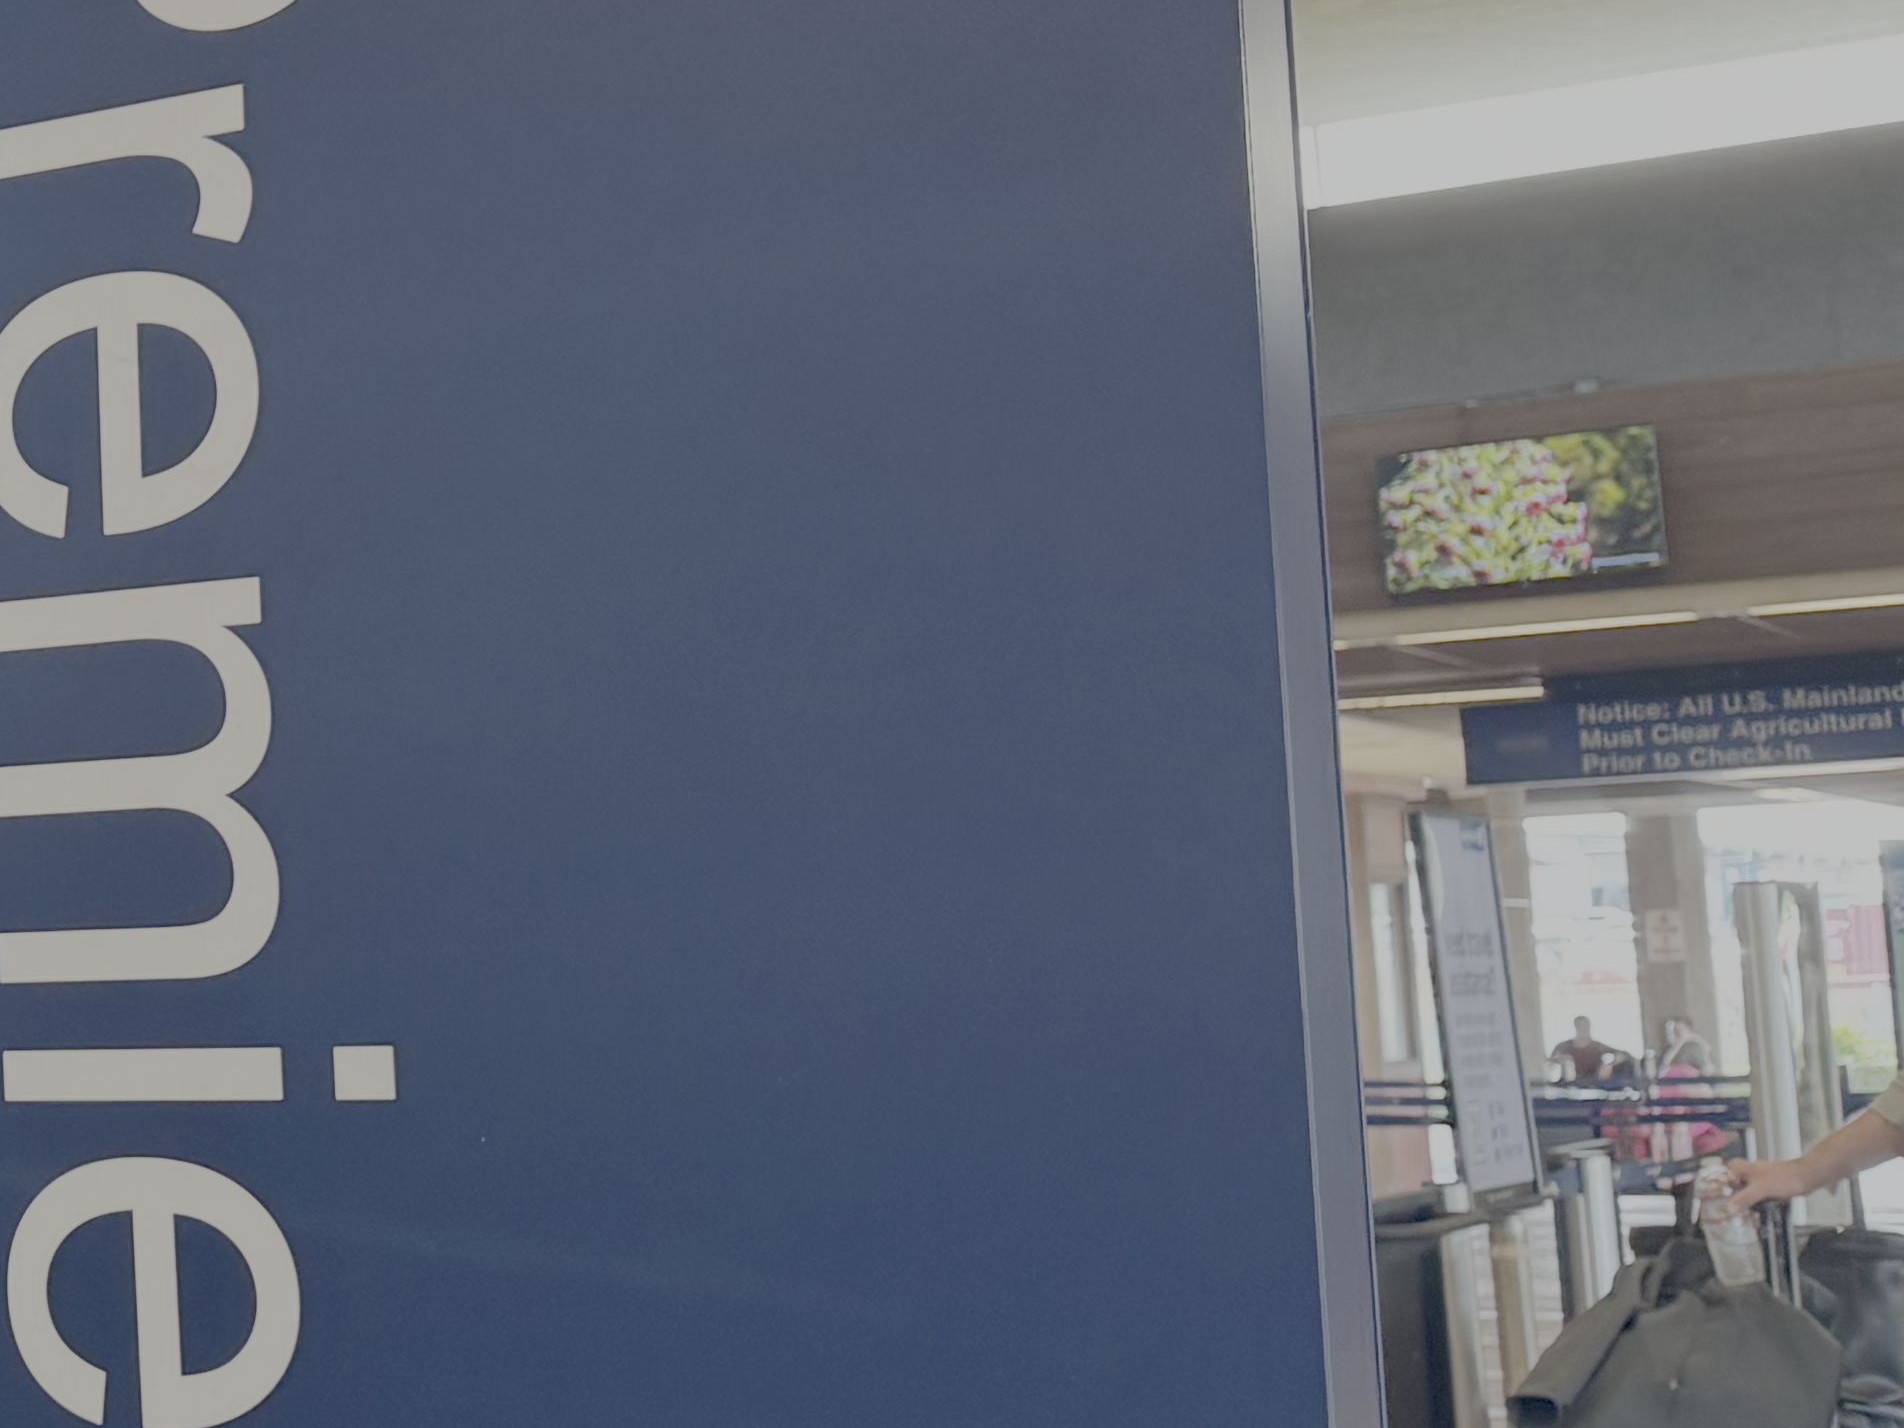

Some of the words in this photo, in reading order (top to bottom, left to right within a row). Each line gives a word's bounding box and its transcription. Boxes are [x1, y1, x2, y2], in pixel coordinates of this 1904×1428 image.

[1577, 702, 1669, 726] Notice:
[1677, 695, 1714, 718] All
[1579, 726, 1644, 751] Must
[1651, 721, 1720, 745] Clear
[1730, 708, 1893, 746] Agricultural
[1582, 748, 1646, 774] Prior
[1652, 746, 1680, 771] to
